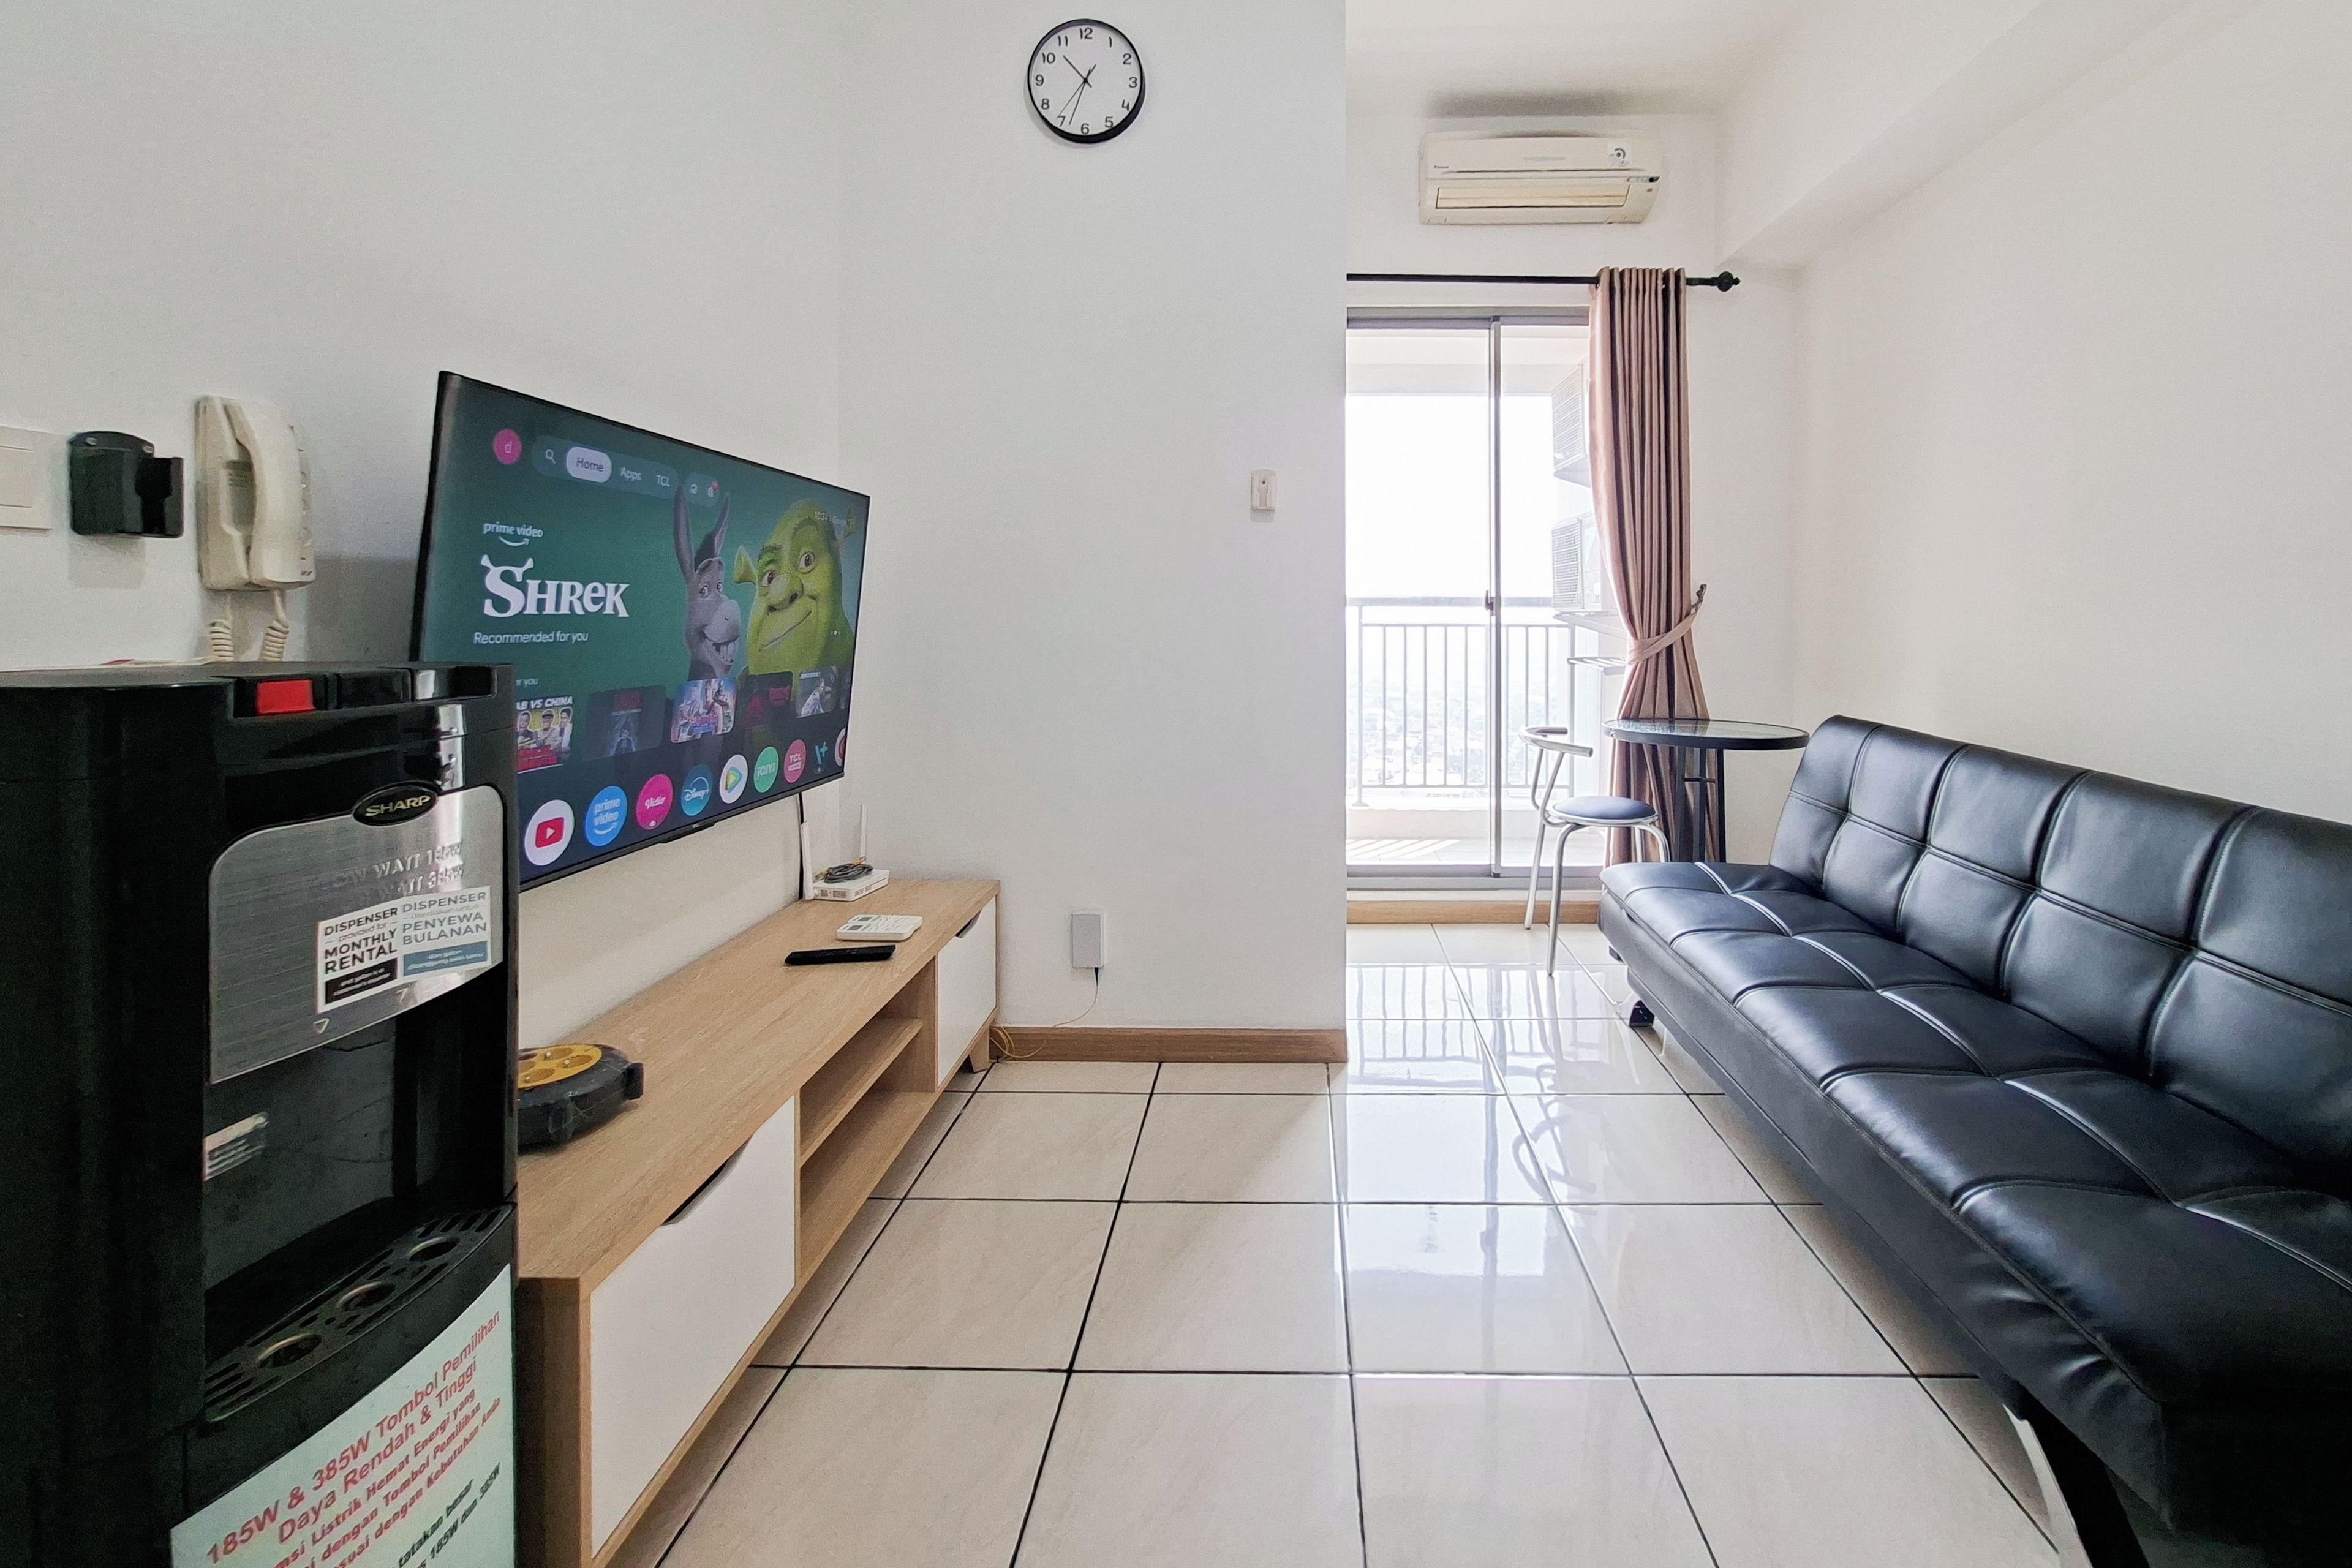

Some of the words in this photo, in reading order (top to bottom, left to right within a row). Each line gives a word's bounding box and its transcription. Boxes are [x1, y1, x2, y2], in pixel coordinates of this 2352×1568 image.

[1080, 27, 1093, 39] 12
[1058, 35, 1068, 47] 11
[1109, 36, 1112, 48] 1
[1042, 52, 1056, 64] 10
[1122, 53, 1132, 65] 2
[1035, 74, 1044, 86] 9
[1129, 77, 1137, 88] 3
[1041, 98, 1050, 110] 8
[1121, 99, 1129, 111] 4
[1058, 115, 1066, 127] 7
[1104, 116, 1114, 128] 5
[1080, 123, 1090, 135] 6
[576, 457, 604, 473] Home
[620, 467, 642, 481] Apps
[656, 474, 671, 488] TCL
[483, 522, 514, 535] prime
[516, 524, 544, 538] video
[473, 631, 554, 644] Recommended
[556, 630, 569, 642] for
[571, 632, 589, 644] you
[524, 677, 539, 688] you
[530, 699, 543, 709] VS
[545, 696, 573, 707] CHINA
[365, 795, 431, 817] SHARP
[594, 798, 621, 815] prime
[644, 796, 667, 810] Vidio
[594, 811, 619, 826] video
[402, 892, 487, 913] DISPENSER
[325, 907, 398, 936] DISPENSER
[402, 911, 484, 933] PENYEWA
[403, 922, 487, 945] BULANAN
[325, 928, 398, 959] MONTHLY
[324, 941, 398, 975] RENTAL
[207, 1499, 279, 1564] 185W
[288, 1486, 305, 1509] &
[312, 1430, 371, 1491] 385W
[375, 1371, 438, 1438] Tombol
[443, 1311, 500, 1381] Pemilihan
[279, 1490, 337, 1544] Daya
[343, 1422, 415, 1494] Rendah
[421, 1405, 431, 1425] &
[435, 1355, 477, 1408] Tinggi
[312, 1498, 363, 1546] Listrik
[366, 1454, 410, 1501] Hemat
[413, 1412, 450, 1457] Energi
[453, 1389, 475, 1421] yang
[322, 1507, 379, 1561] dengan
[383, 1455, 429, 1507] Tombol
[433, 1403, 481, 1460] Pemilihan
[375, 1488, 423, 1539] dengan
[430, 1517, 459, 1559] 185W
